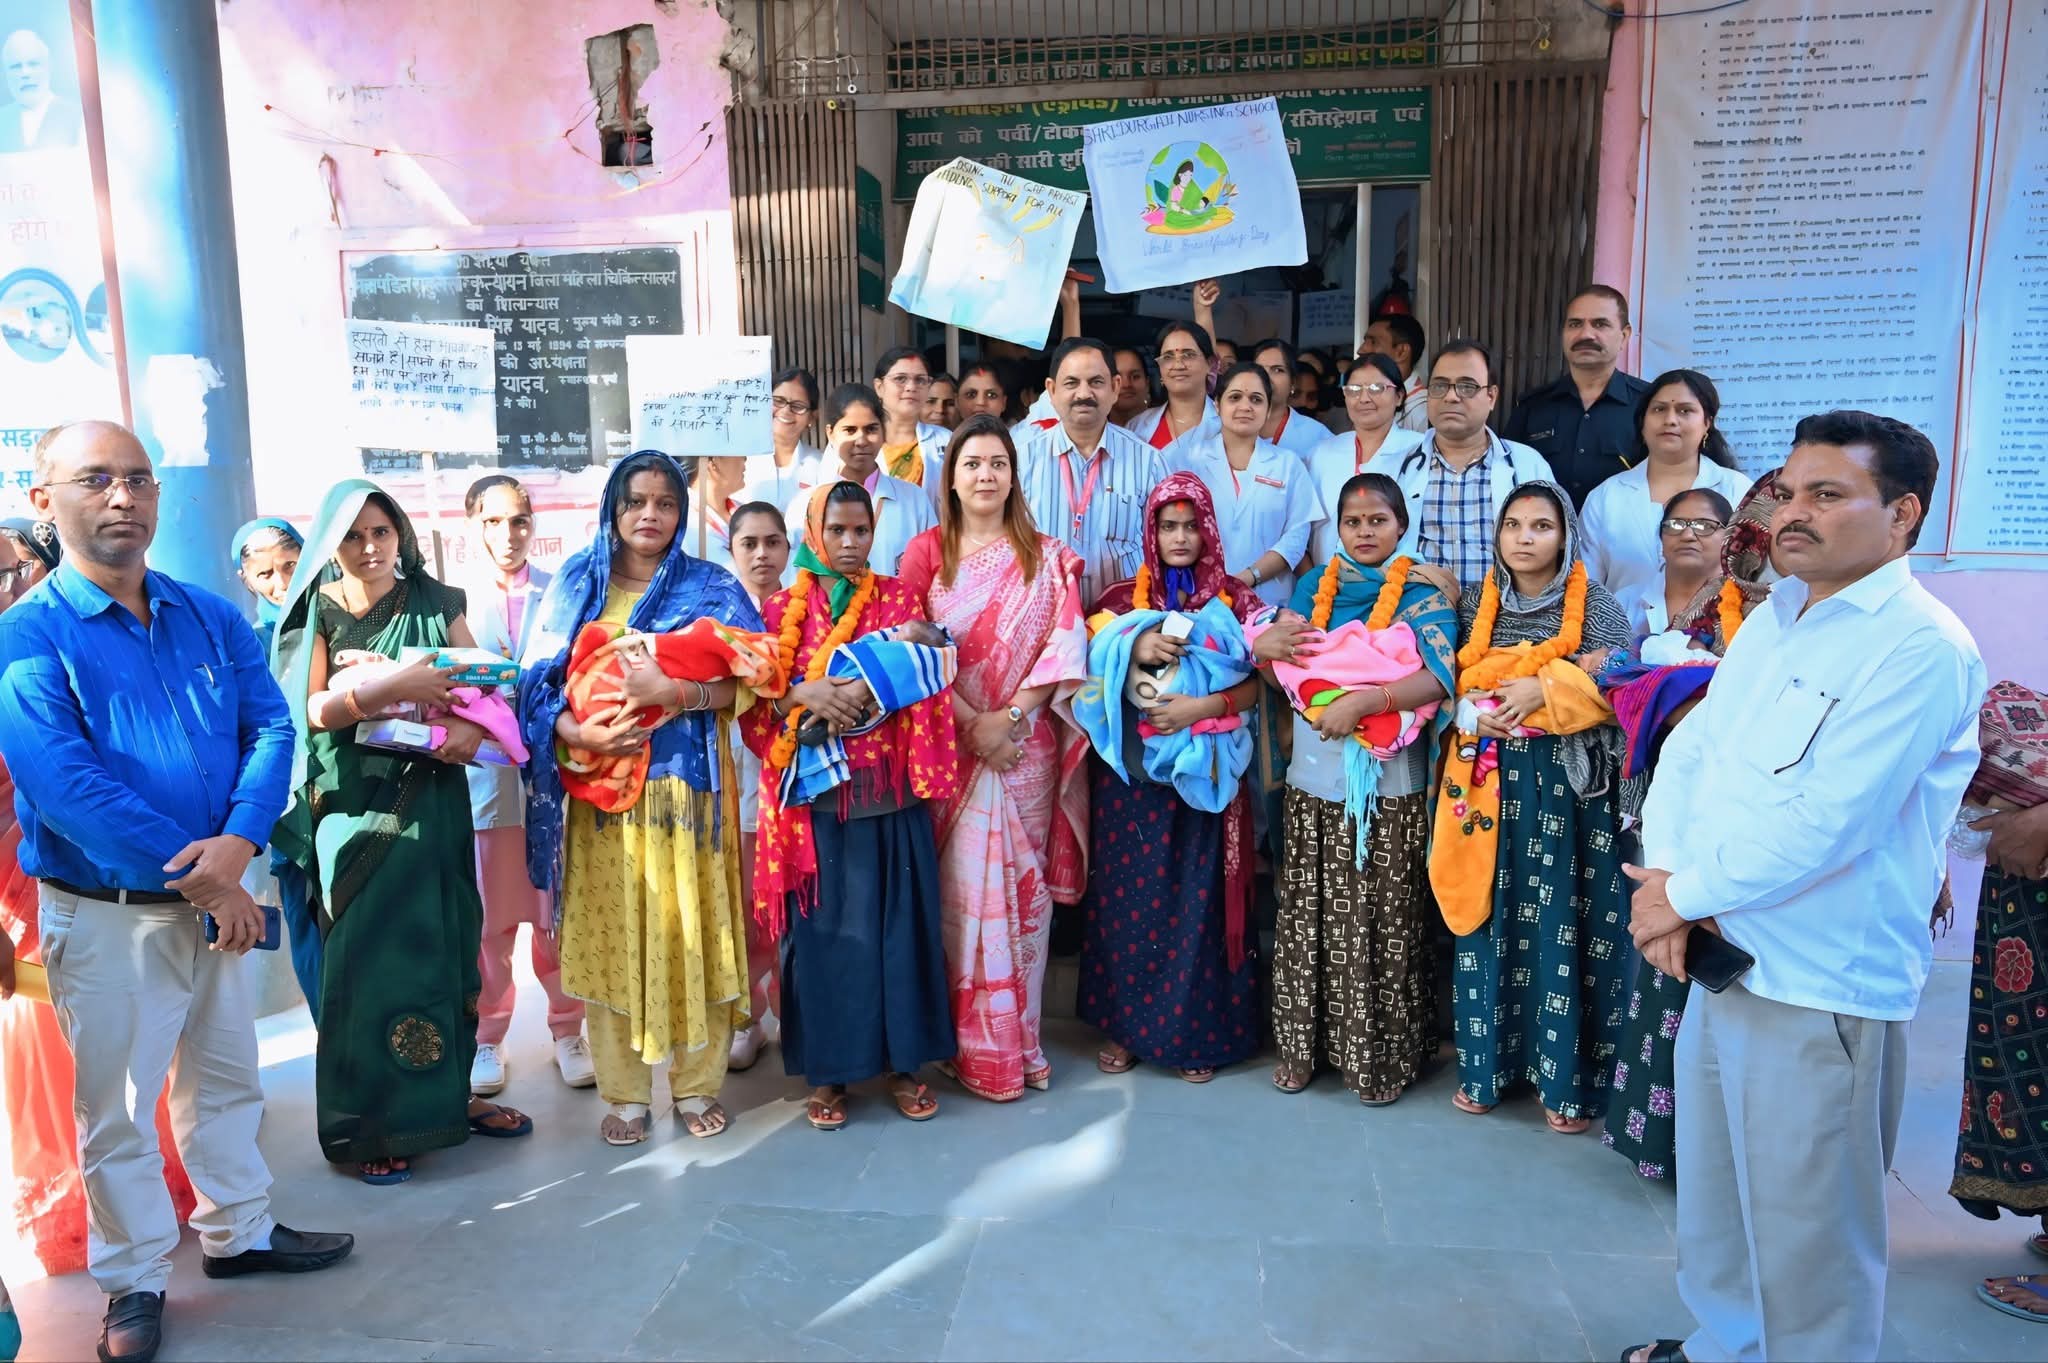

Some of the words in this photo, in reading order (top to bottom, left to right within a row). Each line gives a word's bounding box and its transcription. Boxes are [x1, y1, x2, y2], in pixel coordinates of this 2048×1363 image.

[906, 132, 945, 147] आप
[957, 126, 984, 145] को
[1392, 102, 1426, 123] एवं
[1016, 150, 1053, 169] सारी
[495, 295, 560, 312] शिलान्यास
[498, 352, 519, 370] की
[500, 375, 549, 395] यादव,
